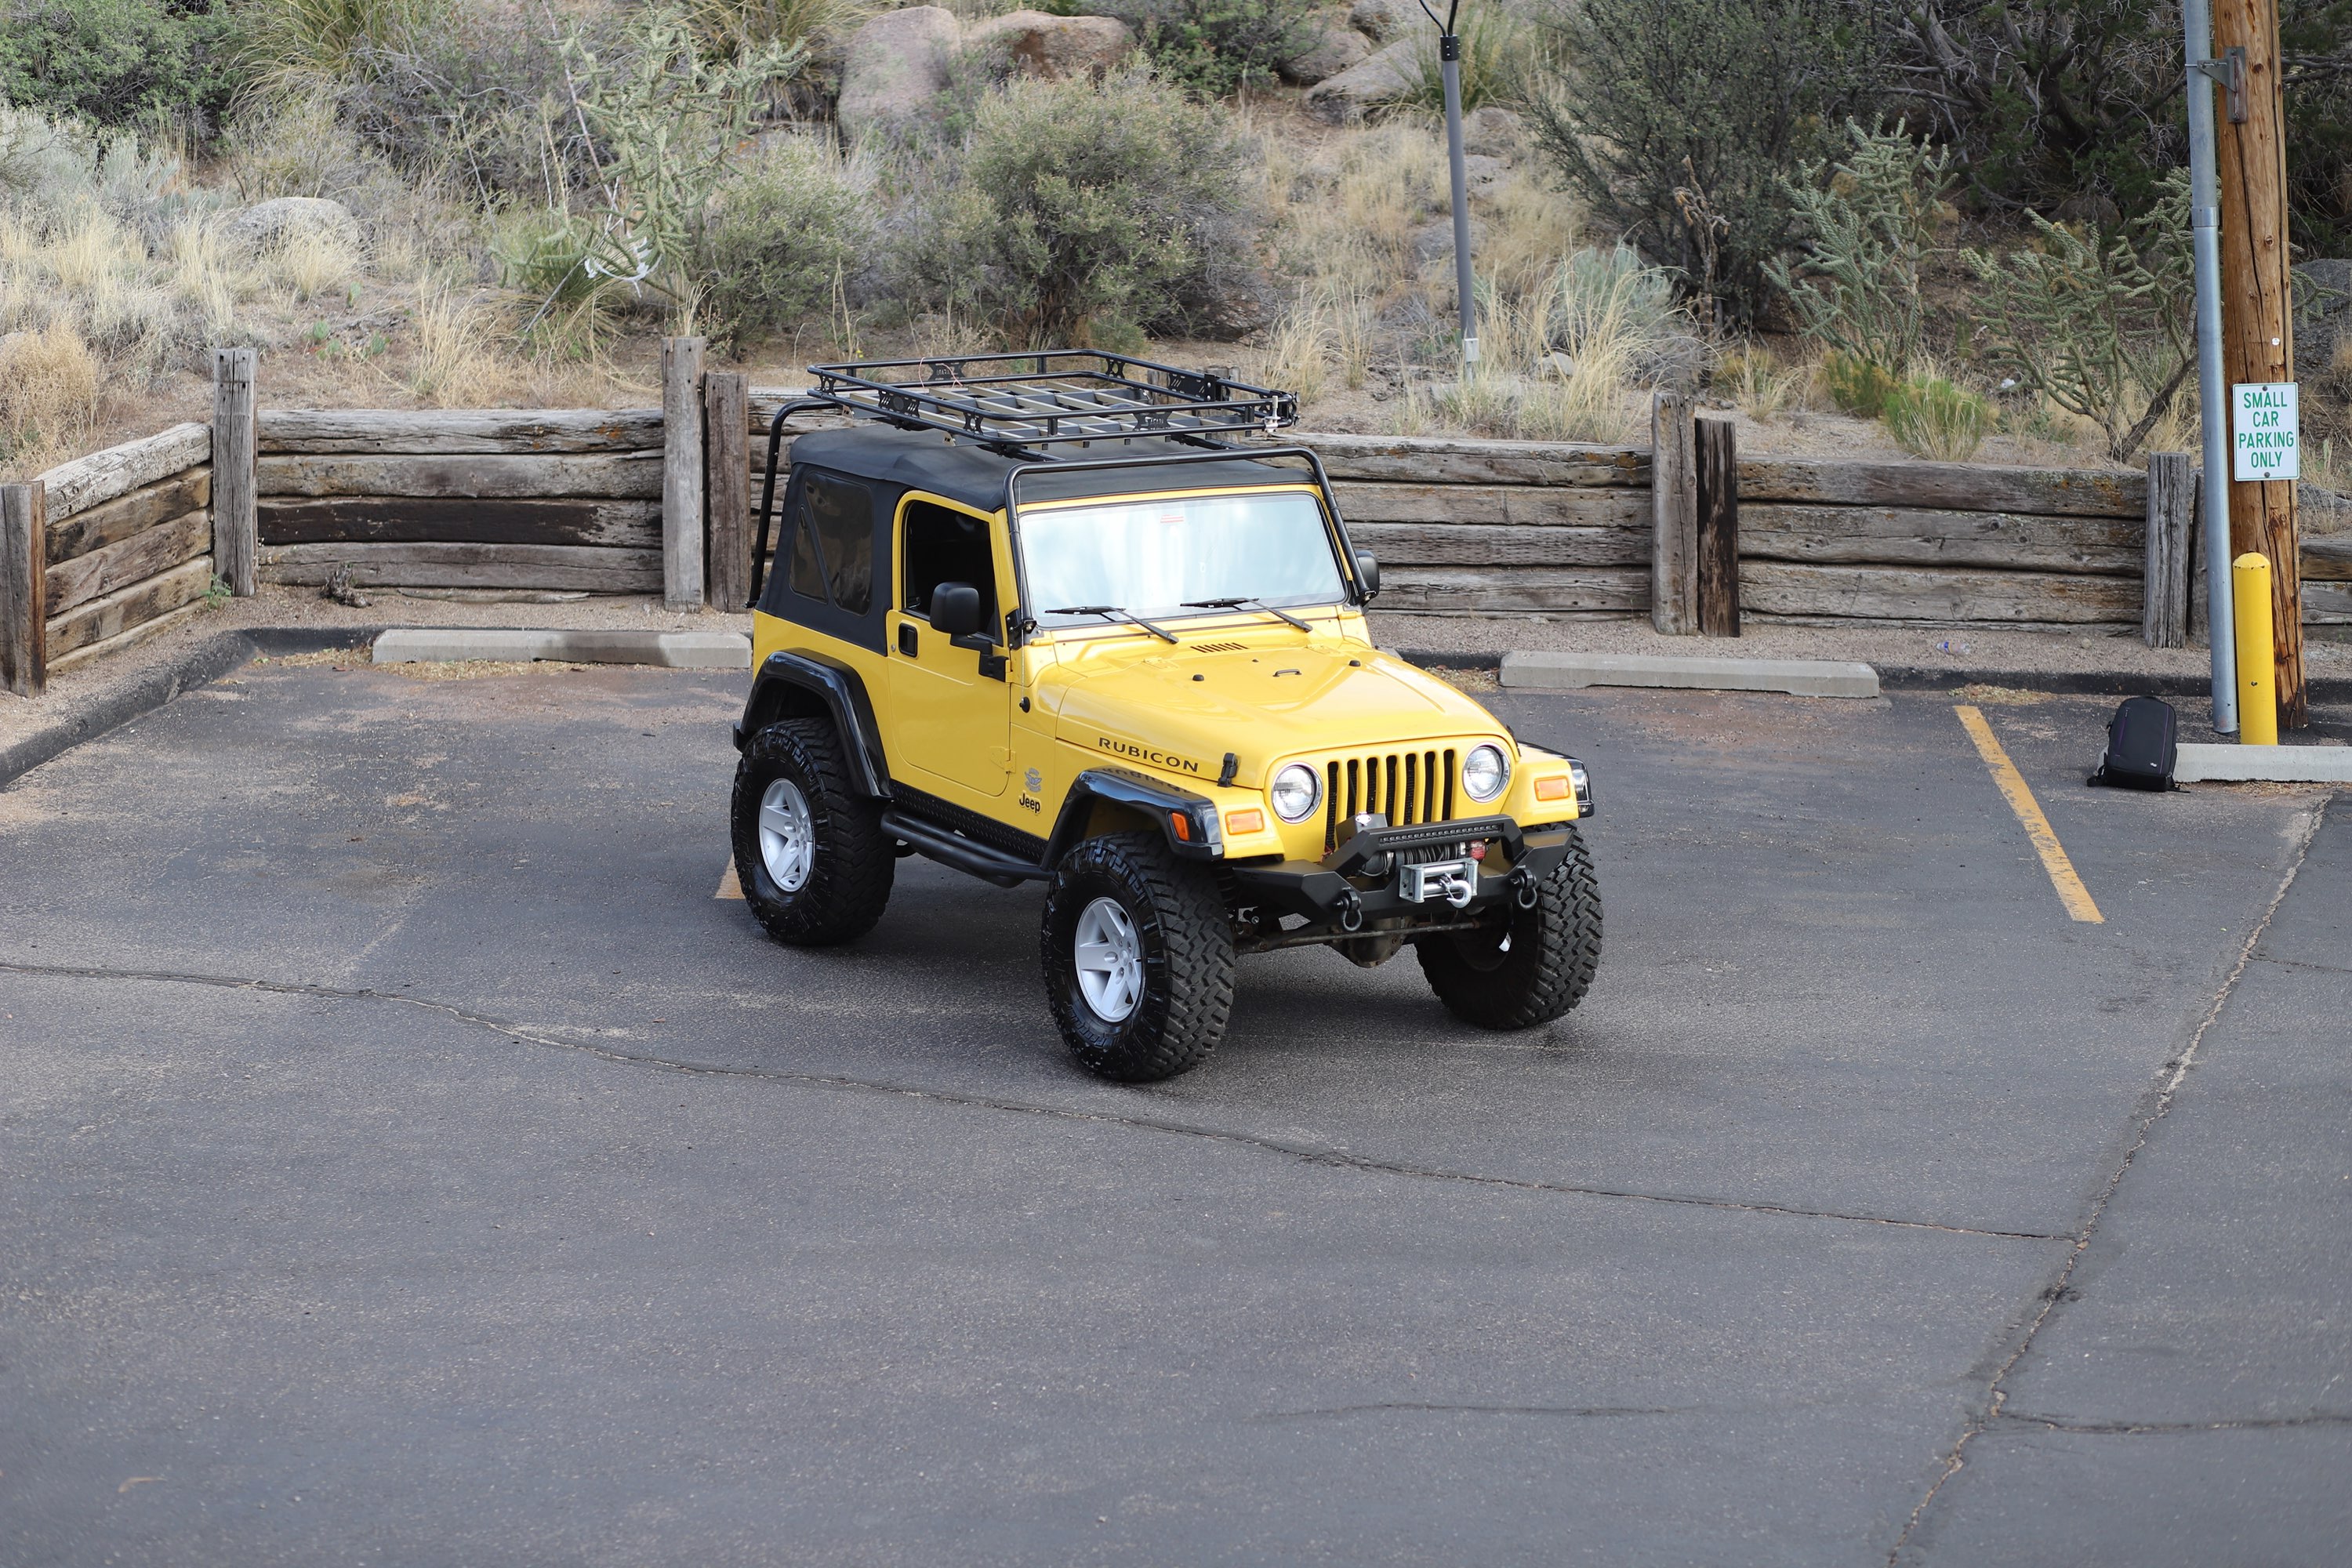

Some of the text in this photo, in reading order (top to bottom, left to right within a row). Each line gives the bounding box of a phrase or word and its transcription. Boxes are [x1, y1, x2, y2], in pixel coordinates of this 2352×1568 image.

[2243, 391, 2288, 408] SMALL
[2252, 411, 2279, 427] CAR
[2239, 431, 2294, 448] PARKING
[2251, 452, 2283, 468] ONLY
[1098, 737, 1199, 773] RUBICON
[1018, 793, 1040, 814] Jeep
